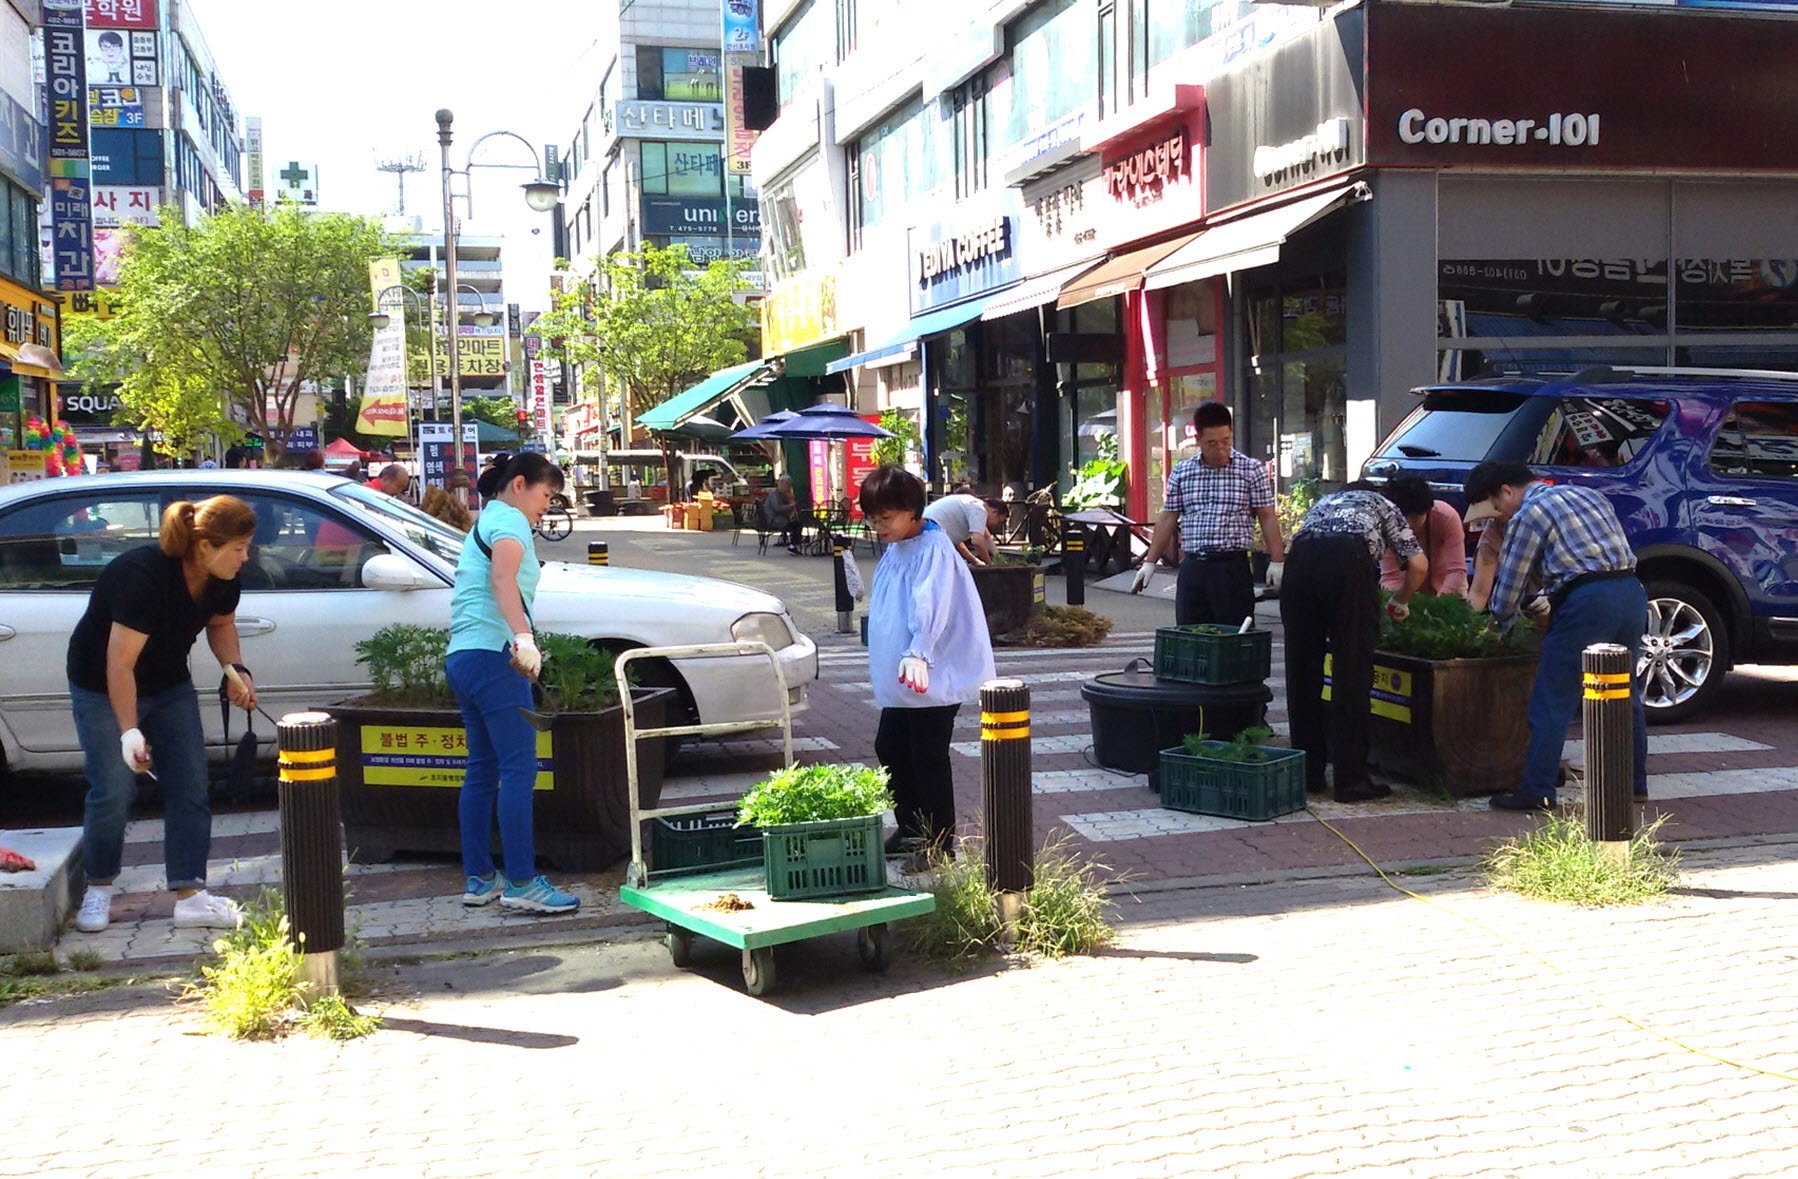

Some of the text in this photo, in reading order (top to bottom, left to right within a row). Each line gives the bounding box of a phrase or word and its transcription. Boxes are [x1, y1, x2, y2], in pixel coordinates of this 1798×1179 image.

[51, 31, 82, 143] 코리아키즈
[126, 112, 143, 125] 3F
[55, 202, 89, 218] 미래
[57, 221, 91, 277] 치과
[67, 395, 124, 413] SQUA
[380, 732, 408, 748] 불법
